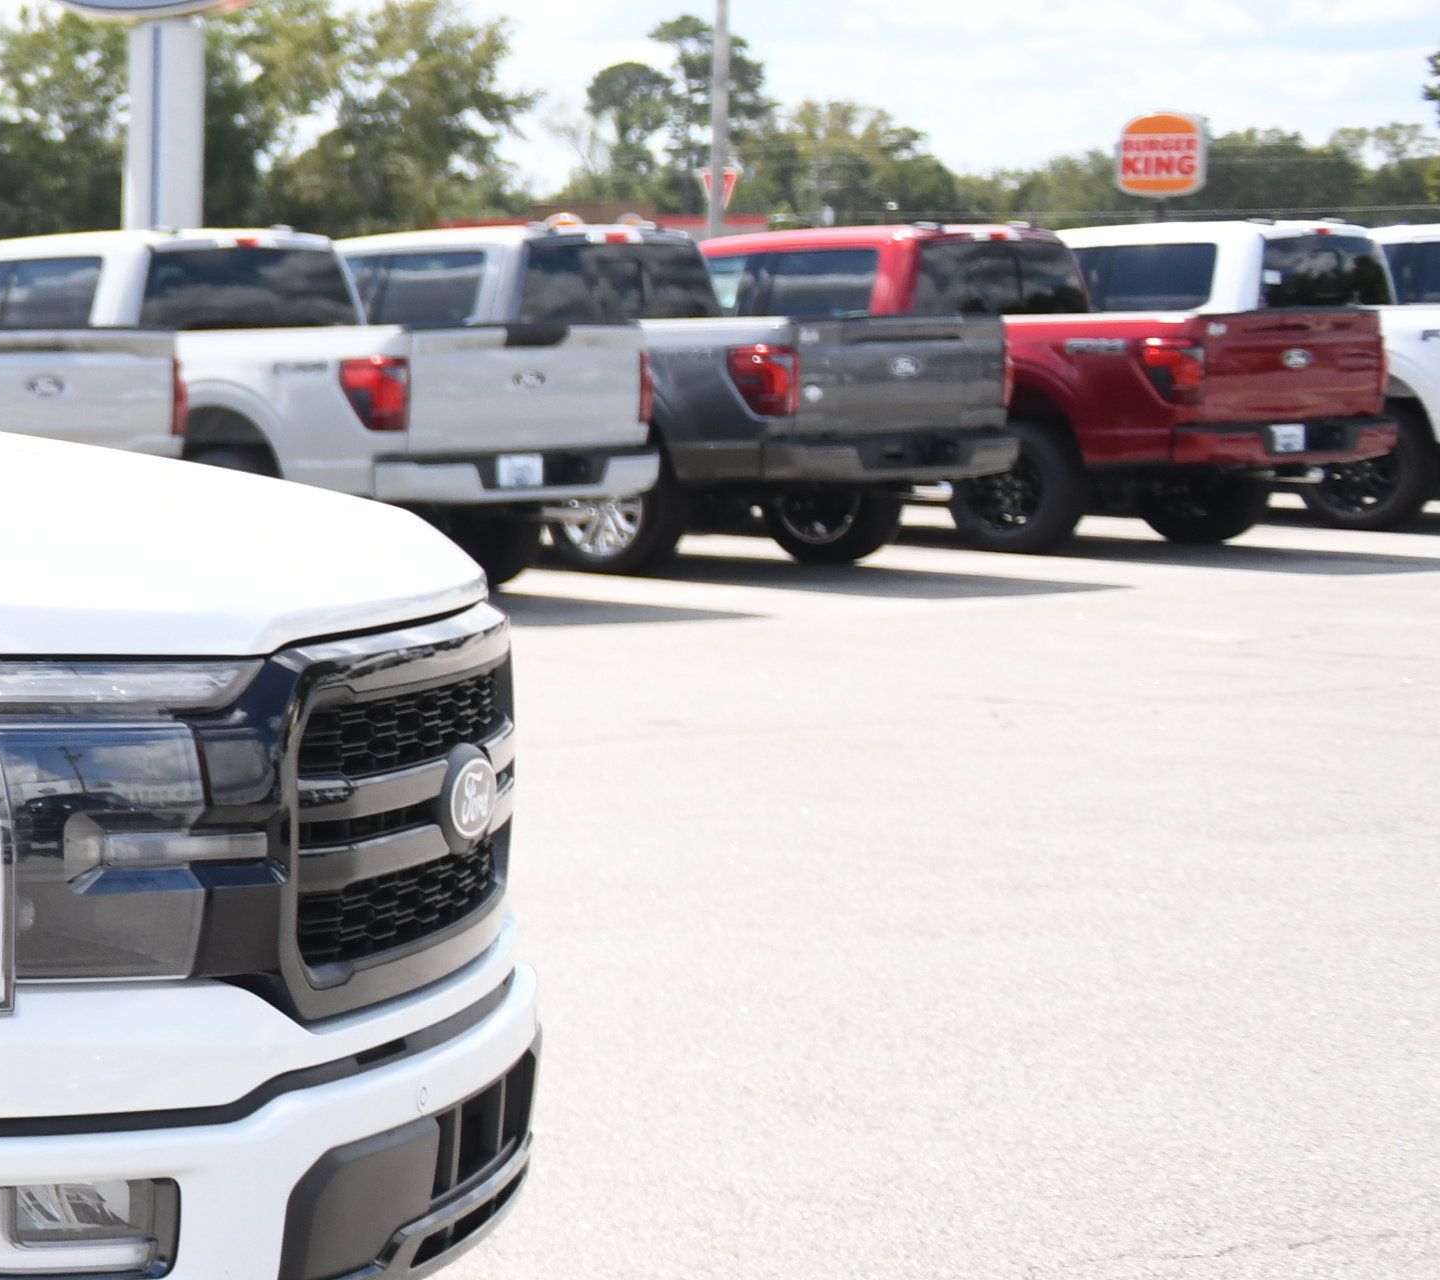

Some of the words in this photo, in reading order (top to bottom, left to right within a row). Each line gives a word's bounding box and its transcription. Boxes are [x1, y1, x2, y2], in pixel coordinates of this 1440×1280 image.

[1123, 138, 1197, 152] BURGER
[1121, 155, 1196, 175] KING
[461, 772, 490, 825] Ford
